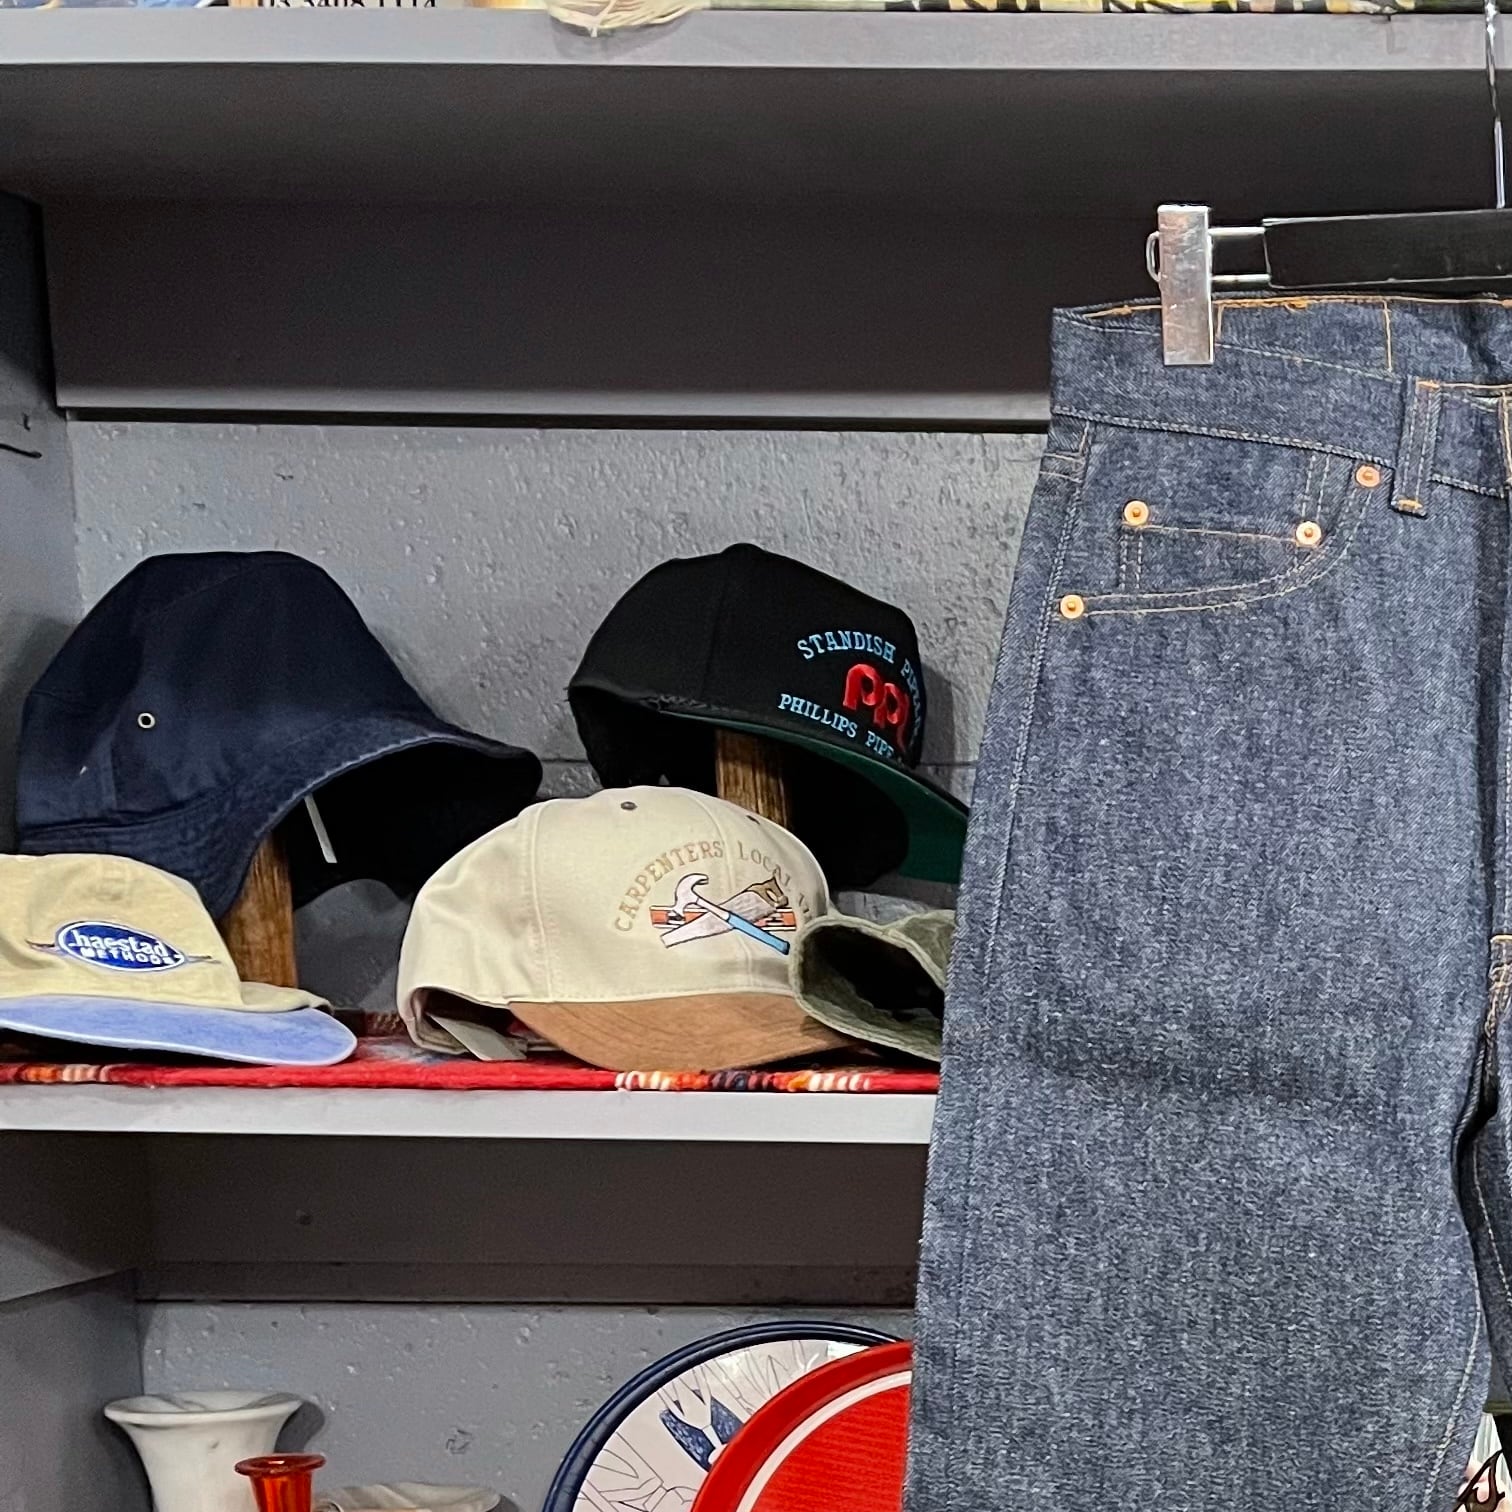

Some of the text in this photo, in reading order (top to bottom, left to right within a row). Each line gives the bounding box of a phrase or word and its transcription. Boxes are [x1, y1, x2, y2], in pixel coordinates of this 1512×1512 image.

[797, 630, 896, 664] STANDISH
[778, 693, 858, 738] PHILLIPS
[614, 840, 724, 932] CARPENTERS
